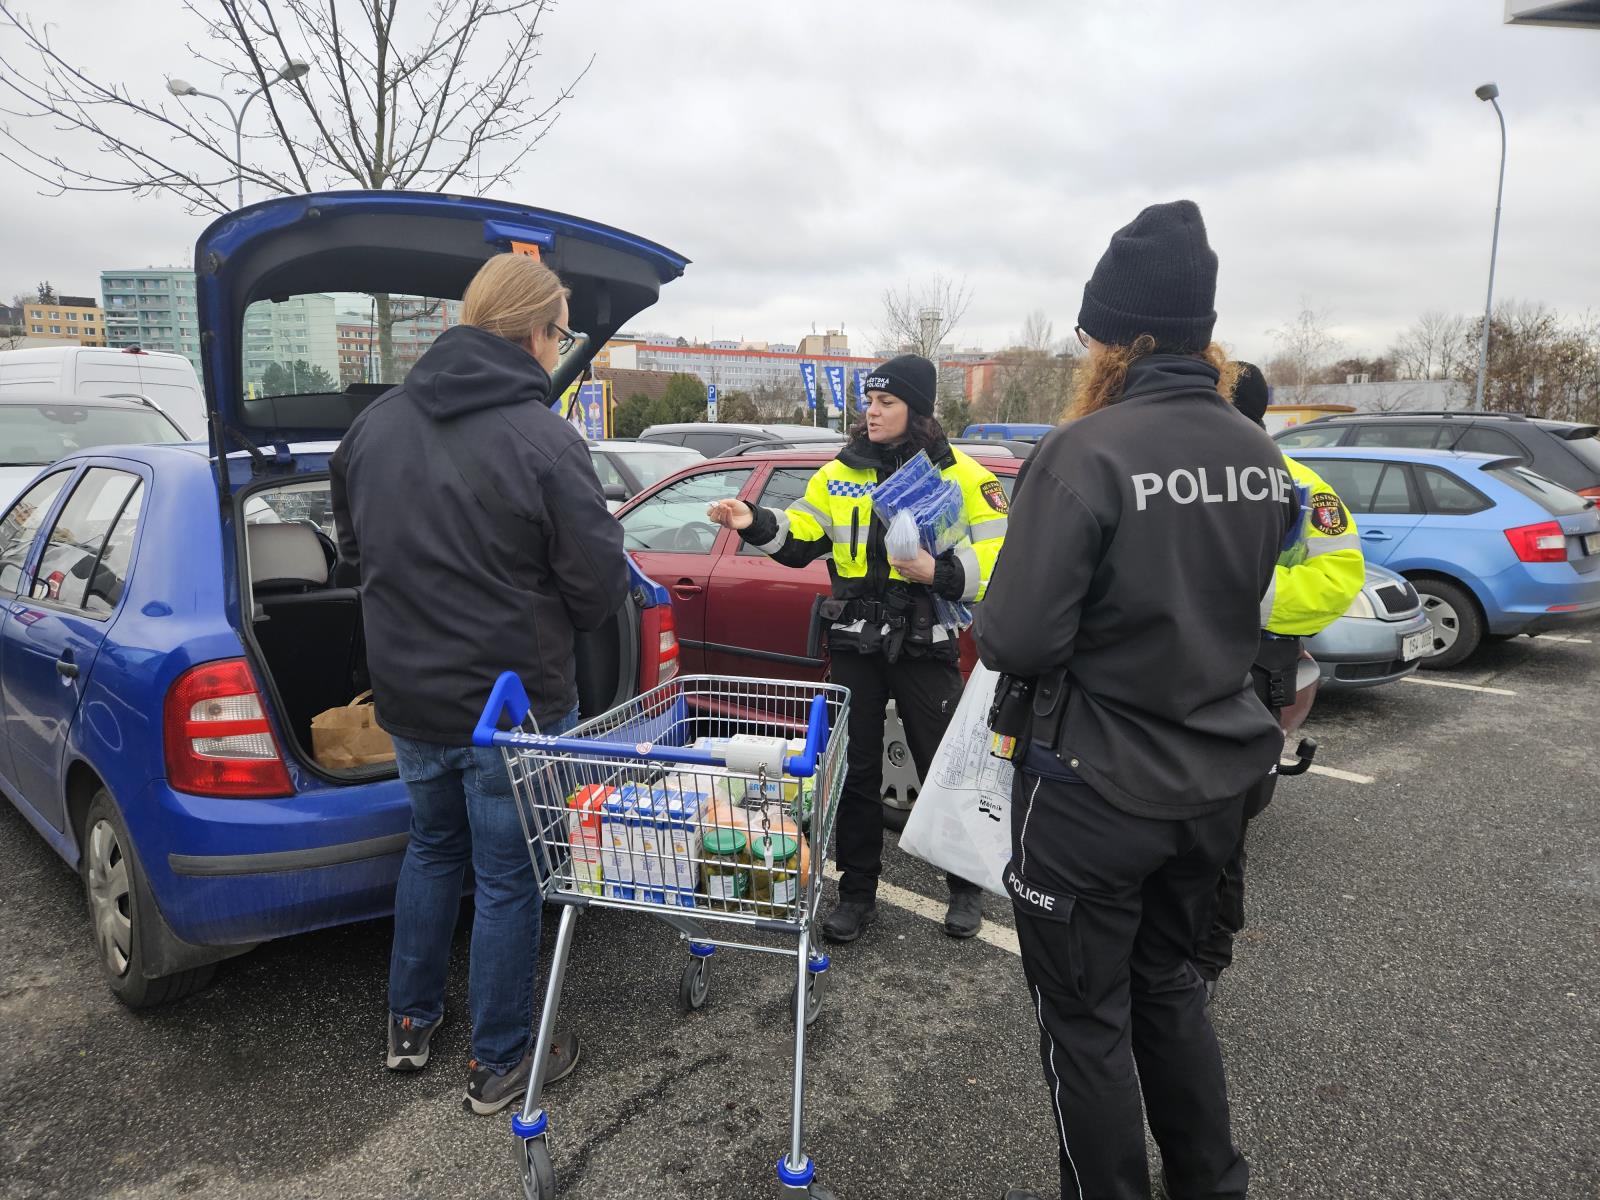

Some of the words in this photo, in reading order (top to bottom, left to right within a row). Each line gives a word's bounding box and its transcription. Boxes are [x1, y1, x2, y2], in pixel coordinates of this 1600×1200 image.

[709, 386, 715, 397] P
[1131, 466, 1292, 511] POLICIE
[1008, 871, 1056, 911] POLICIE
